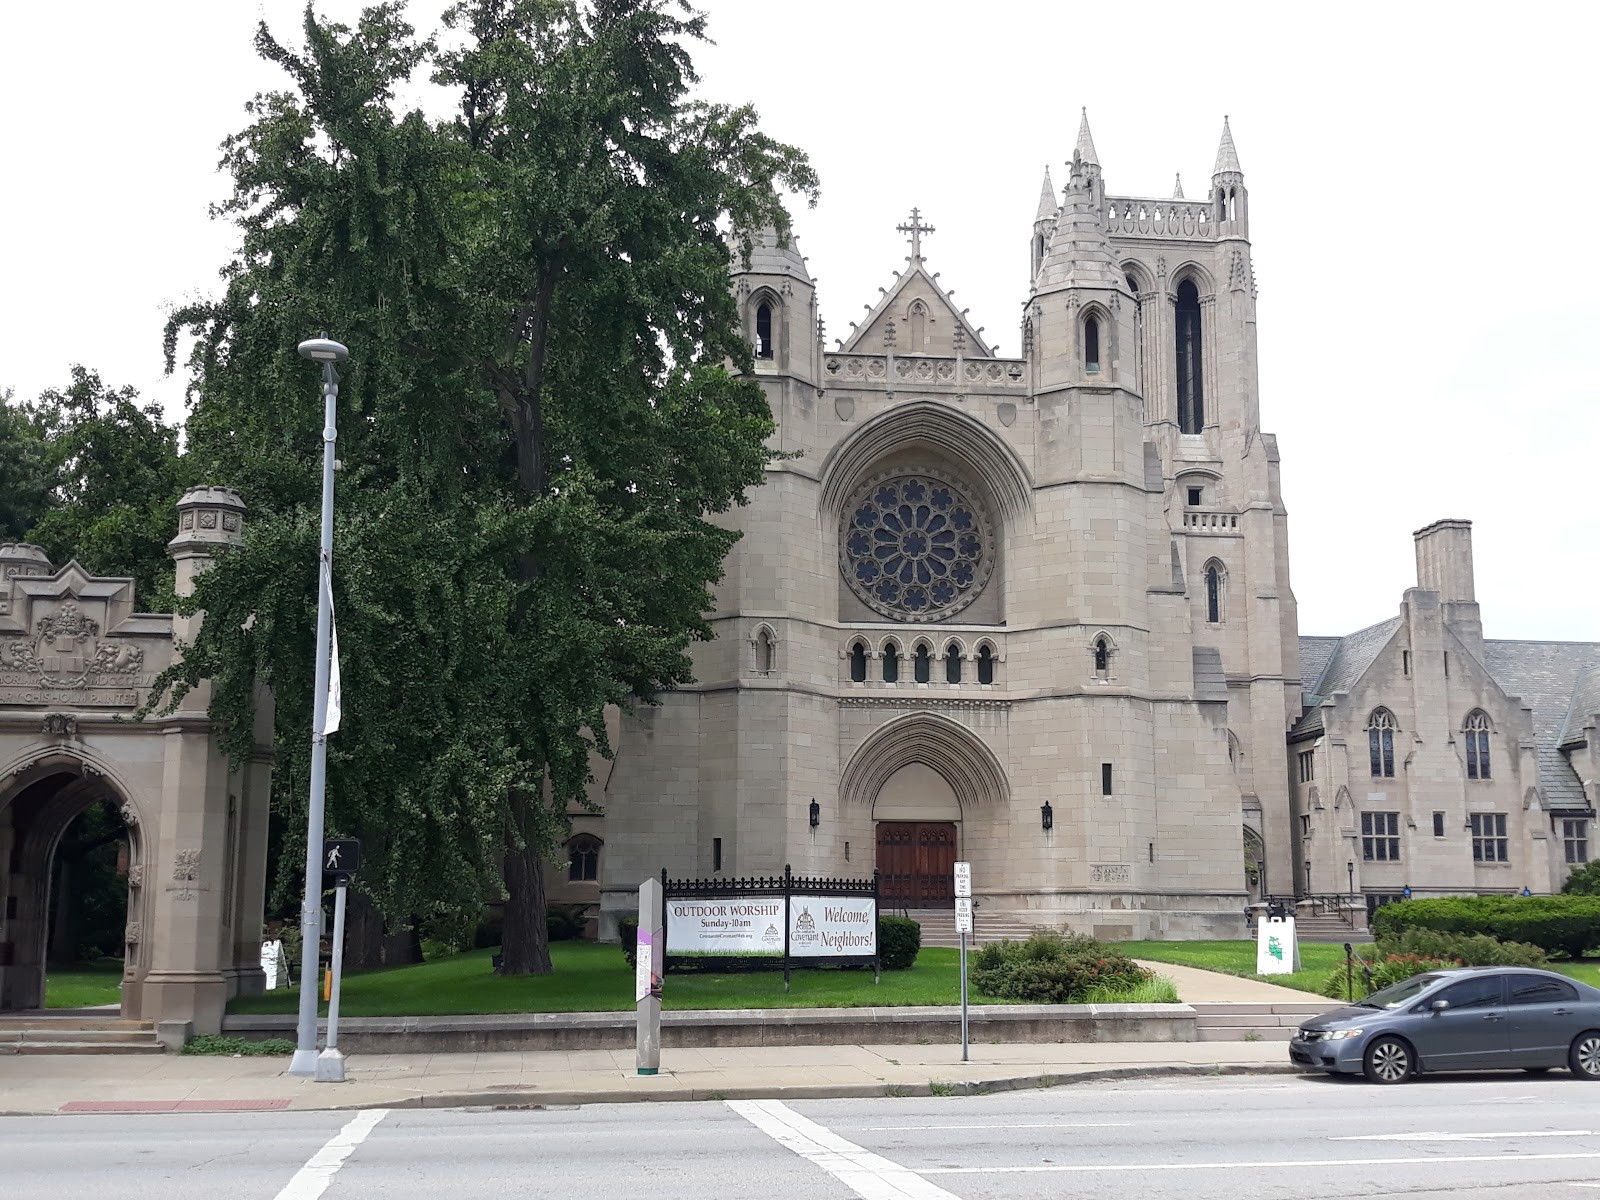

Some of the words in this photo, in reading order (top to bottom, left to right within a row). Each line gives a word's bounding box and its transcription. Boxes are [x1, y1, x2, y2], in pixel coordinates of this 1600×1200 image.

[91, 693, 138, 704] PAINTER
[674, 906, 727, 917] OUTDOOR
[730, 905, 780, 916] WORSHIP
[824, 906, 870, 925] Welcome,
[701, 918, 751, 929] Sunday-10am
[791, 931, 819, 942] Covenant
[820, 931, 874, 953] Neighbors!
